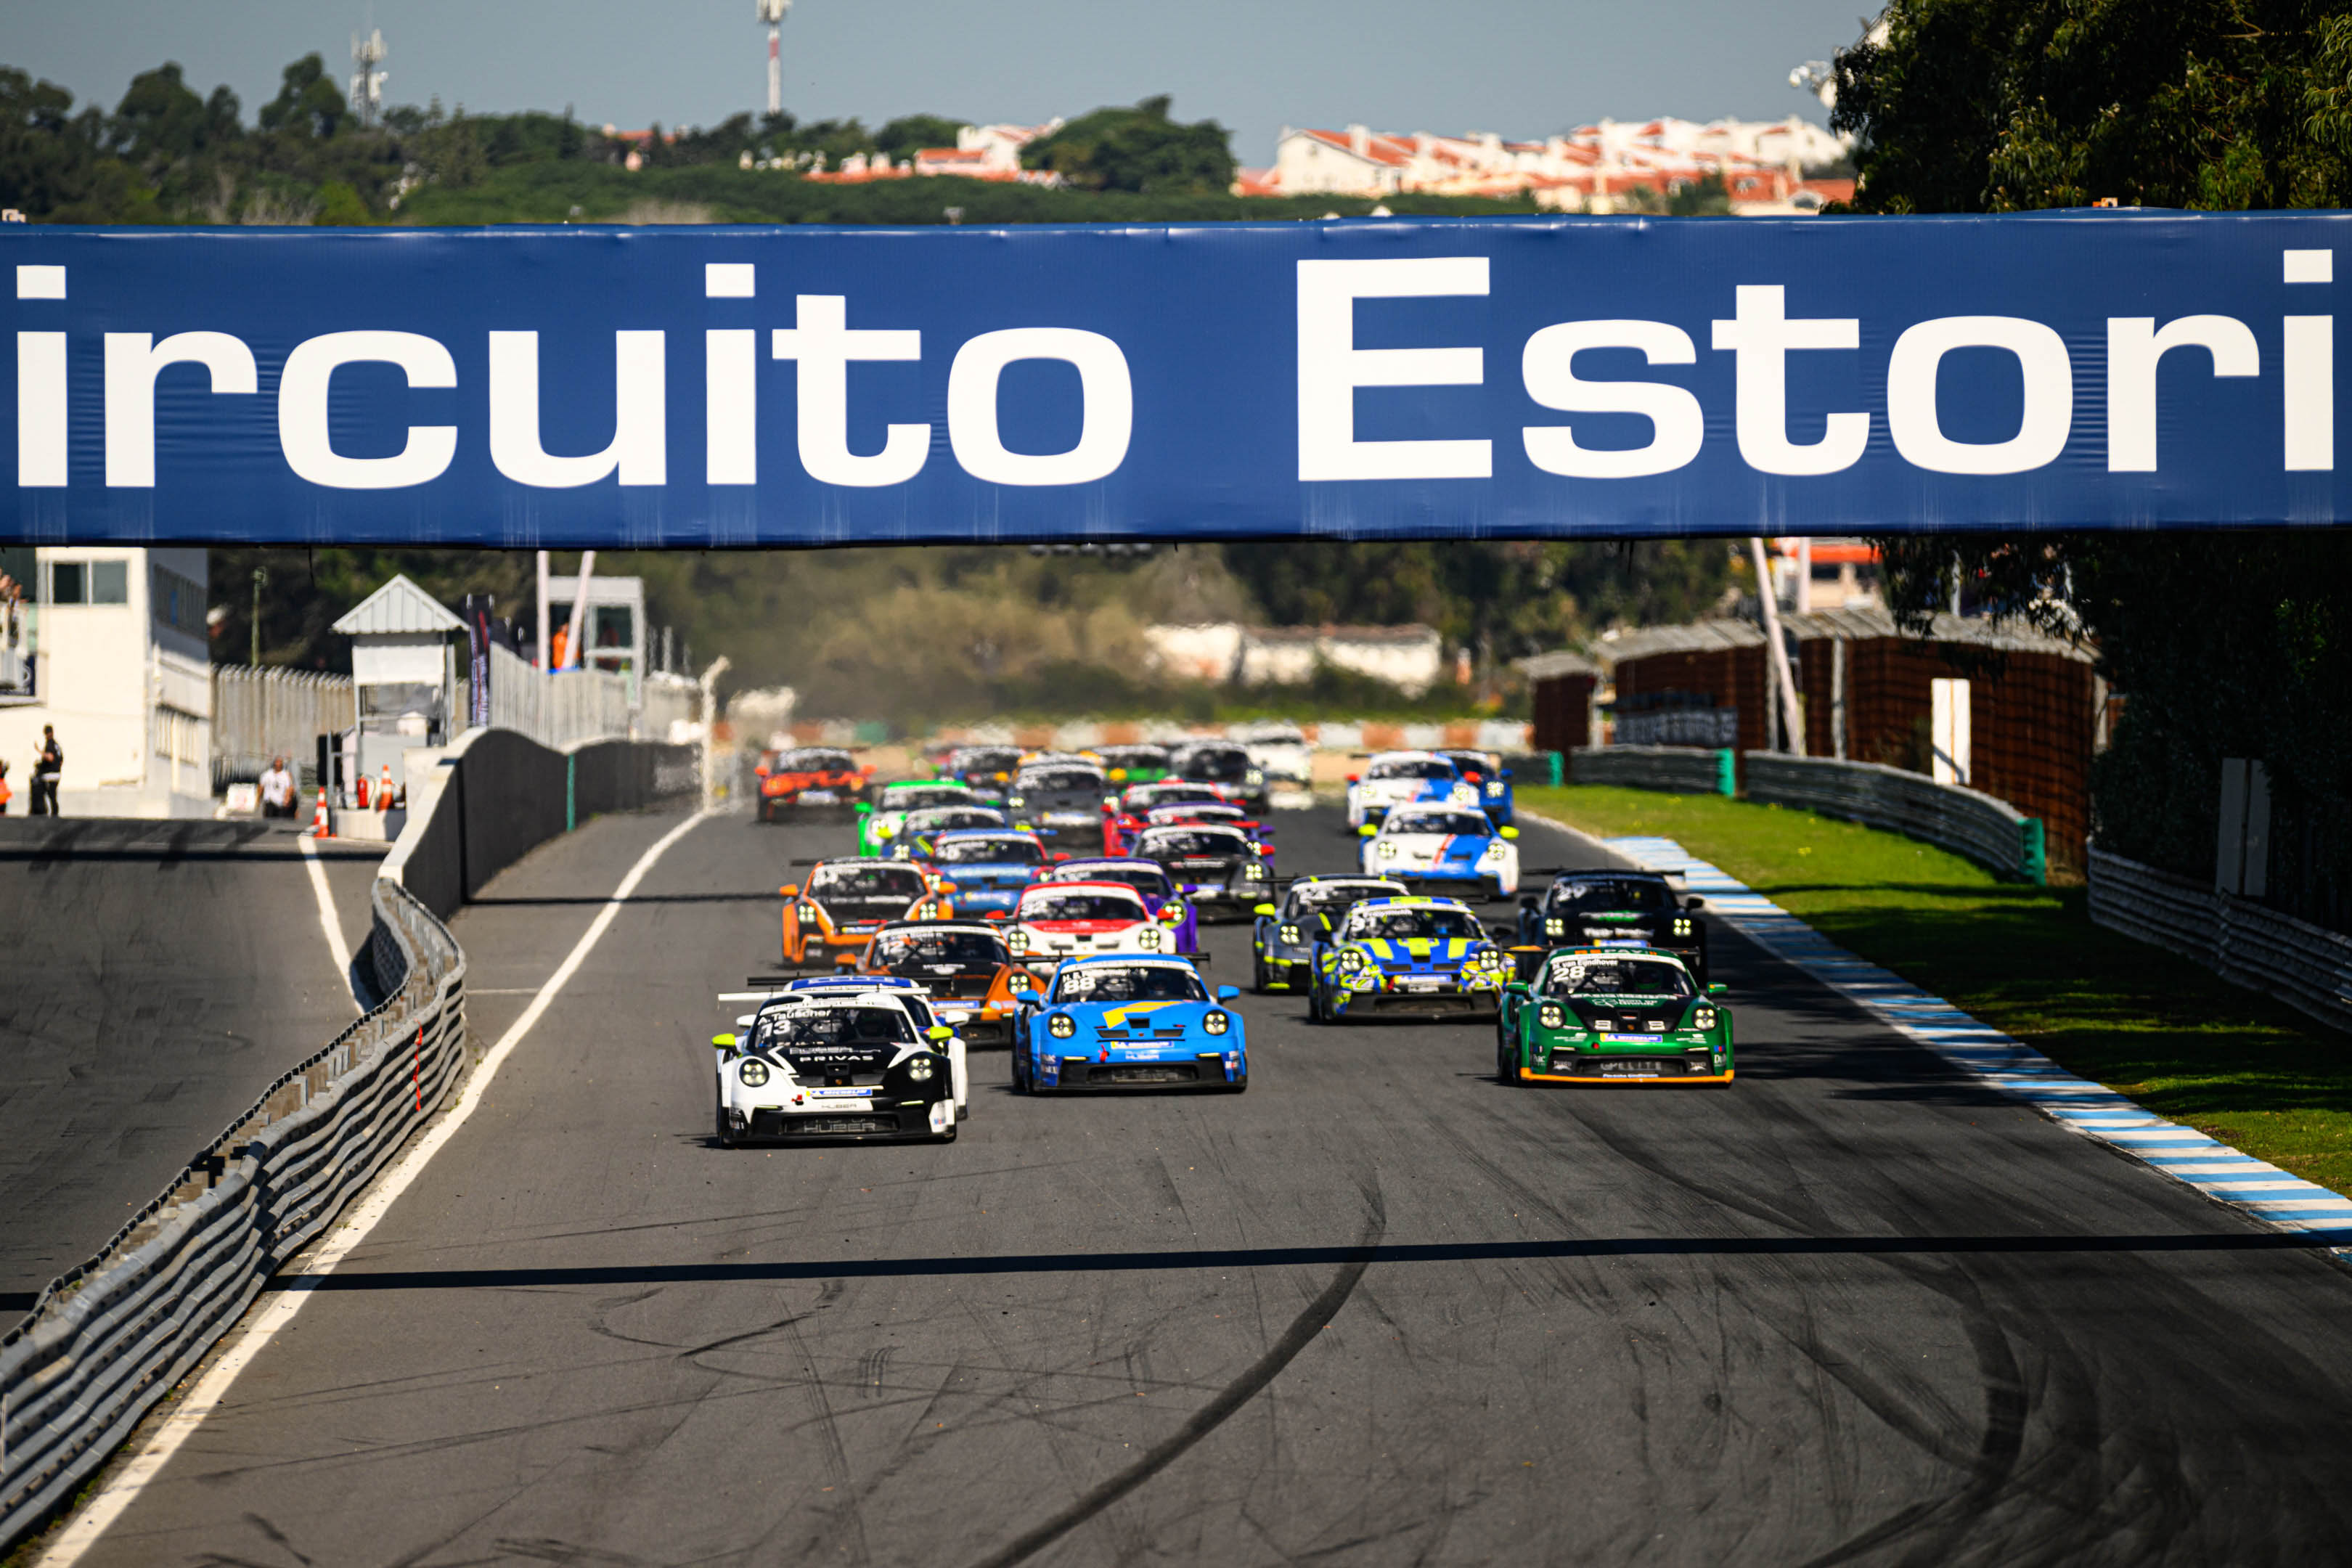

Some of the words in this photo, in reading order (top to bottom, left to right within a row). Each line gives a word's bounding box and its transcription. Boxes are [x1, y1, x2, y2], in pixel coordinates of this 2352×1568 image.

[16, 263, 1134, 489] ircuito
[1297, 250, 2334, 481] Estori
[1553, 966, 1585, 983] 28
[1063, 977, 1096, 995] 88
[761, 1019, 791, 1039] 13
[803, 1122, 876, 1133] HUBER
